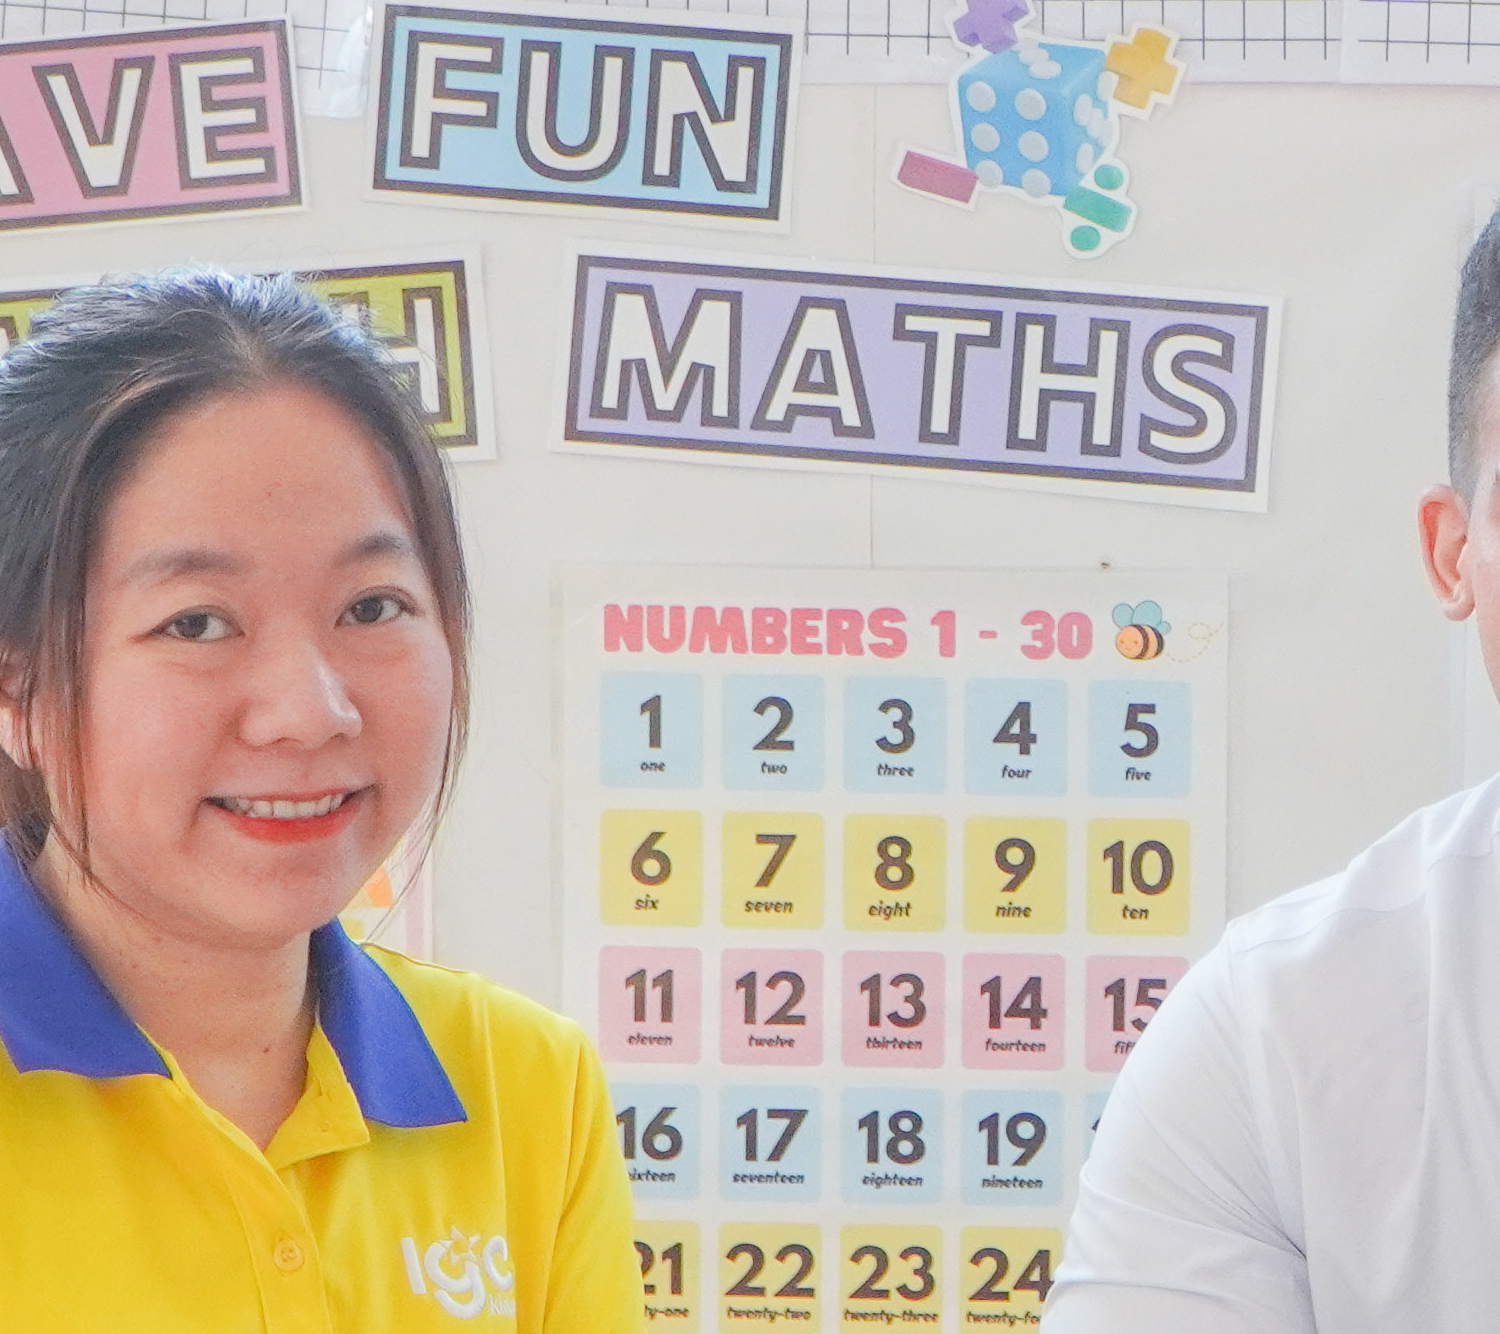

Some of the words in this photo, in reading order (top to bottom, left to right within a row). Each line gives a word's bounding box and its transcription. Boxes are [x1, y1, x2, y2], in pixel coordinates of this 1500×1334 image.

[399, 30, 768, 194] FUN
[588, 282, 1238, 465] MATHS
[603, 603, 909, 658] NUMBERS
[930, 609, 956, 658] 1
[1020, 611, 1095, 661] 30
[639, 694, 662, 749] 1
[752, 695, 795, 752] 2
[875, 698, 916, 755] 3
[992, 700, 1038, 756] 4
[1119, 702, 1160, 759] 5
[639, 761, 666, 772] one
[760, 760, 788, 775] two
[876, 763, 915, 777] three
[1001, 764, 1032, 779] four
[1124, 766, 1152, 781] five
[630, 830, 672, 886] 6
[754, 833, 798, 888] 7
[874, 835, 915, 891] 8
[994, 837, 1036, 893] 9
[1102, 839, 1175, 896] 10
[634, 893, 660, 911] six
[744, 900, 794, 914] seven
[867, 900, 912, 921] eight
[995, 901, 1032, 919] nine
[1121, 904, 1150, 920] ten
[624, 968, 674, 1023] 11
[735, 970, 807, 1026] 12
[859, 972, 927, 1029] 13
[980, 975, 1049, 1031] 14
[984, 1037, 1047, 1053] fourteen
[617, 1105, 684, 1162] 16
[736, 1107, 809, 1162] 17
[857, 1109, 926, 1165] 18
[978, 1111, 1047, 1167] 19
[732, 1171, 805, 1184] seventeen
[861, 1172, 924, 1190] eighteen
[981, 1174, 1044, 1189] nineteen
[724, 1242, 816, 1299] 22
[848, 1244, 936, 1302] 23
[967, 1247, 1056, 1305] 24
